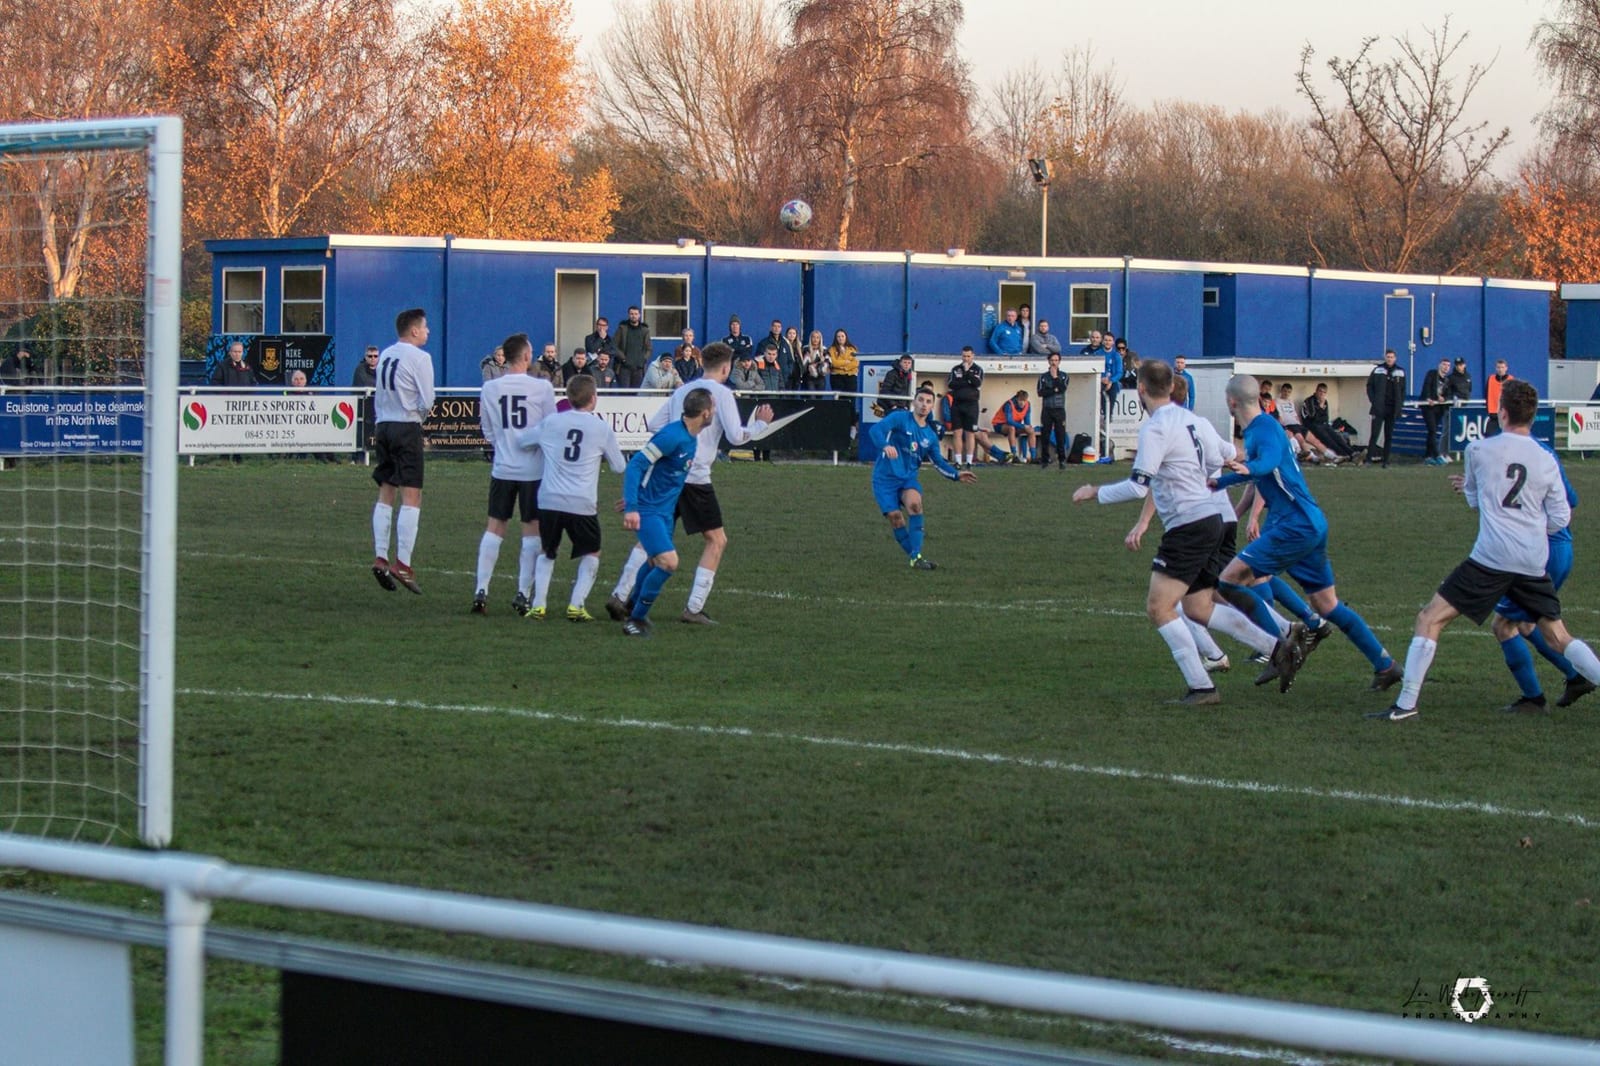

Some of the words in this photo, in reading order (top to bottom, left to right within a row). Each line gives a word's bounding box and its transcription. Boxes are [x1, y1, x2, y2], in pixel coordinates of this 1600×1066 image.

[285, 349, 302, 358] NIKE
[285, 359, 315, 369] PARTNER
[381, 357, 400, 391] 11
[6, 402, 49, 414] Equistone
[56, 402, 82, 414] proud
[84, 403, 93, 412] to
[95, 402, 106, 412] be
[107, 401, 145, 412] dealmak
[225, 401, 260, 412] TRIPLE
[262, 401, 269, 411] S
[270, 401, 306, 411] SPORTS
[308, 401, 316, 411] &
[441, 400, 474, 418] SON
[498, 395, 528, 430] 15
[46, 416, 54, 426] in
[55, 416, 69, 426] the
[71, 416, 95, 426] North
[97, 416, 118, 426] West
[211, 414, 294, 426] ENTERTAINMENT
[295, 414, 329, 425] GROUP
[245, 430, 264, 439] 0845
[265, 430, 279, 439] 521
[281, 430, 296, 439] 255
[563, 428, 584, 462] 3
[1501, 462, 1528, 509] 2
